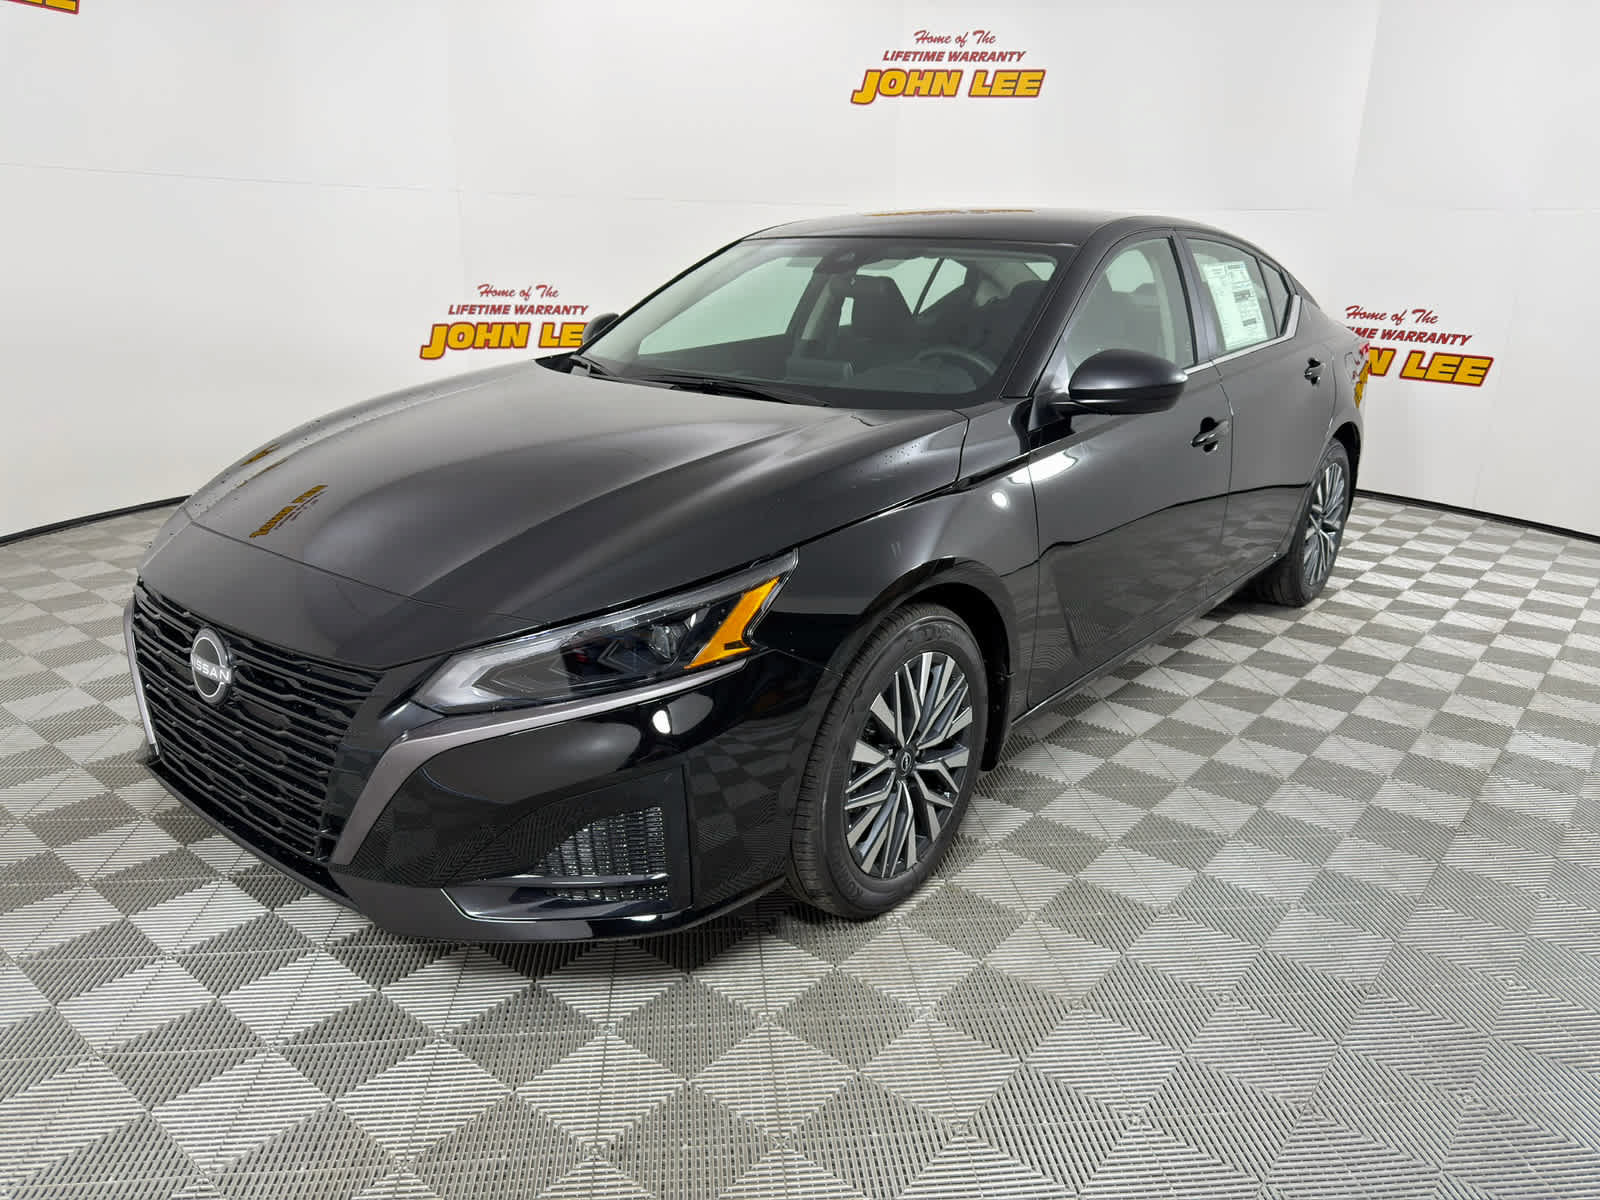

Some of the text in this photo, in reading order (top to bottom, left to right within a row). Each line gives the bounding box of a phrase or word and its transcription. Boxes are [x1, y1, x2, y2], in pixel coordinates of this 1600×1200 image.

[913, 29, 997, 48] Home of The
[882, 50, 1026, 62] LIFETIME WARRANTY
[850, 68, 1046, 105] JOHN LEE
[477, 283, 560, 301] Home of The
[448, 304, 588, 315] LIFETIME WARRANTY
[1344, 305, 1439, 326] Home of The
[419, 321, 588, 360] JOHN LE
[1380, 328, 1472, 346] WARRANTY
[1399, 349, 1494, 388] LEE
[191, 655, 230, 682] ISSAN
